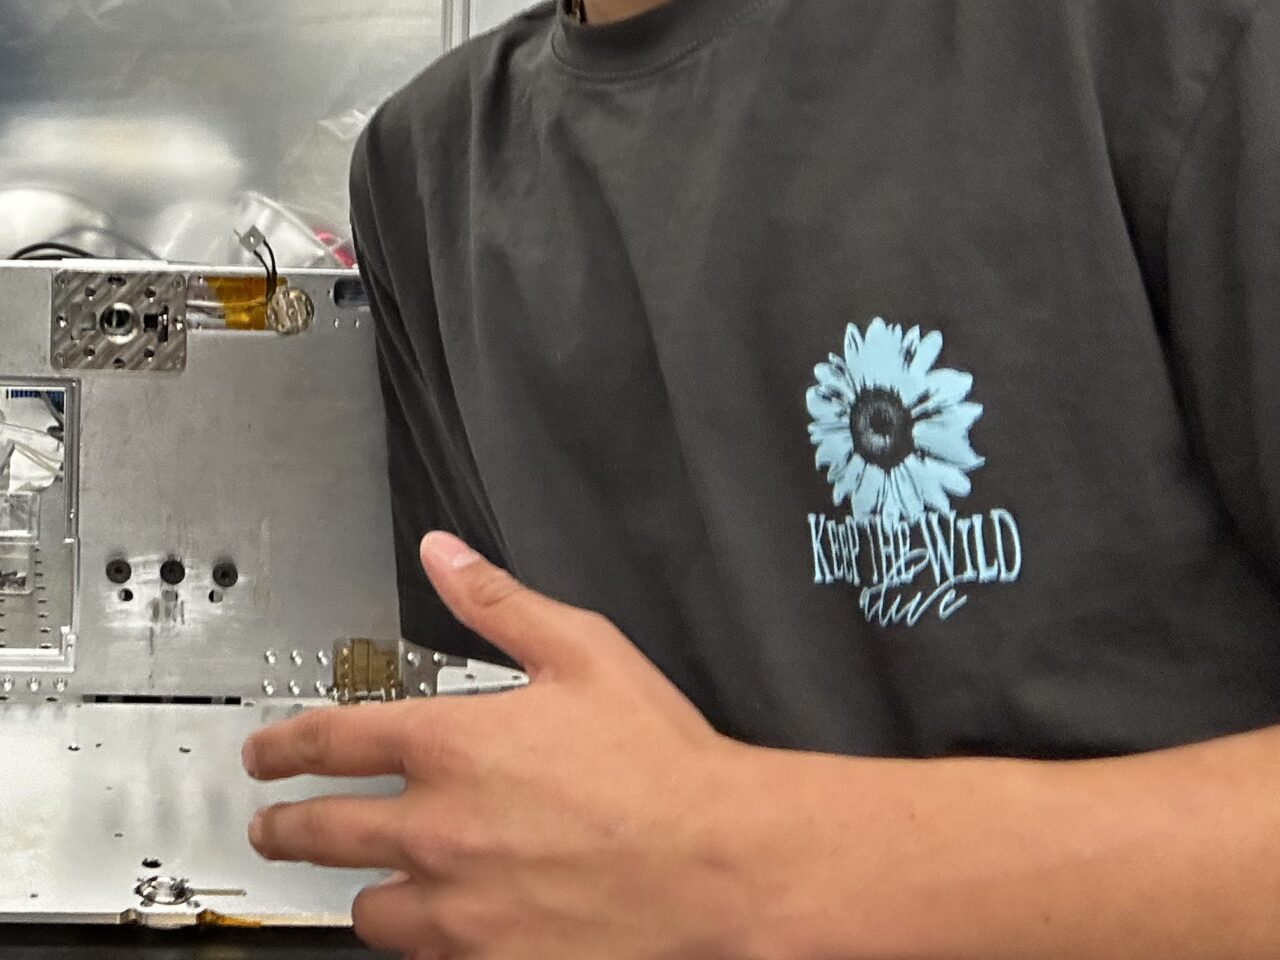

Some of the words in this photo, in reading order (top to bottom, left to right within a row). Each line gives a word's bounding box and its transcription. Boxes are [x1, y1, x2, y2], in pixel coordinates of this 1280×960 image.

[807, 513, 860, 587] KEEP
[863, 514, 915, 586] THE
[919, 508, 1022, 587] WILD
